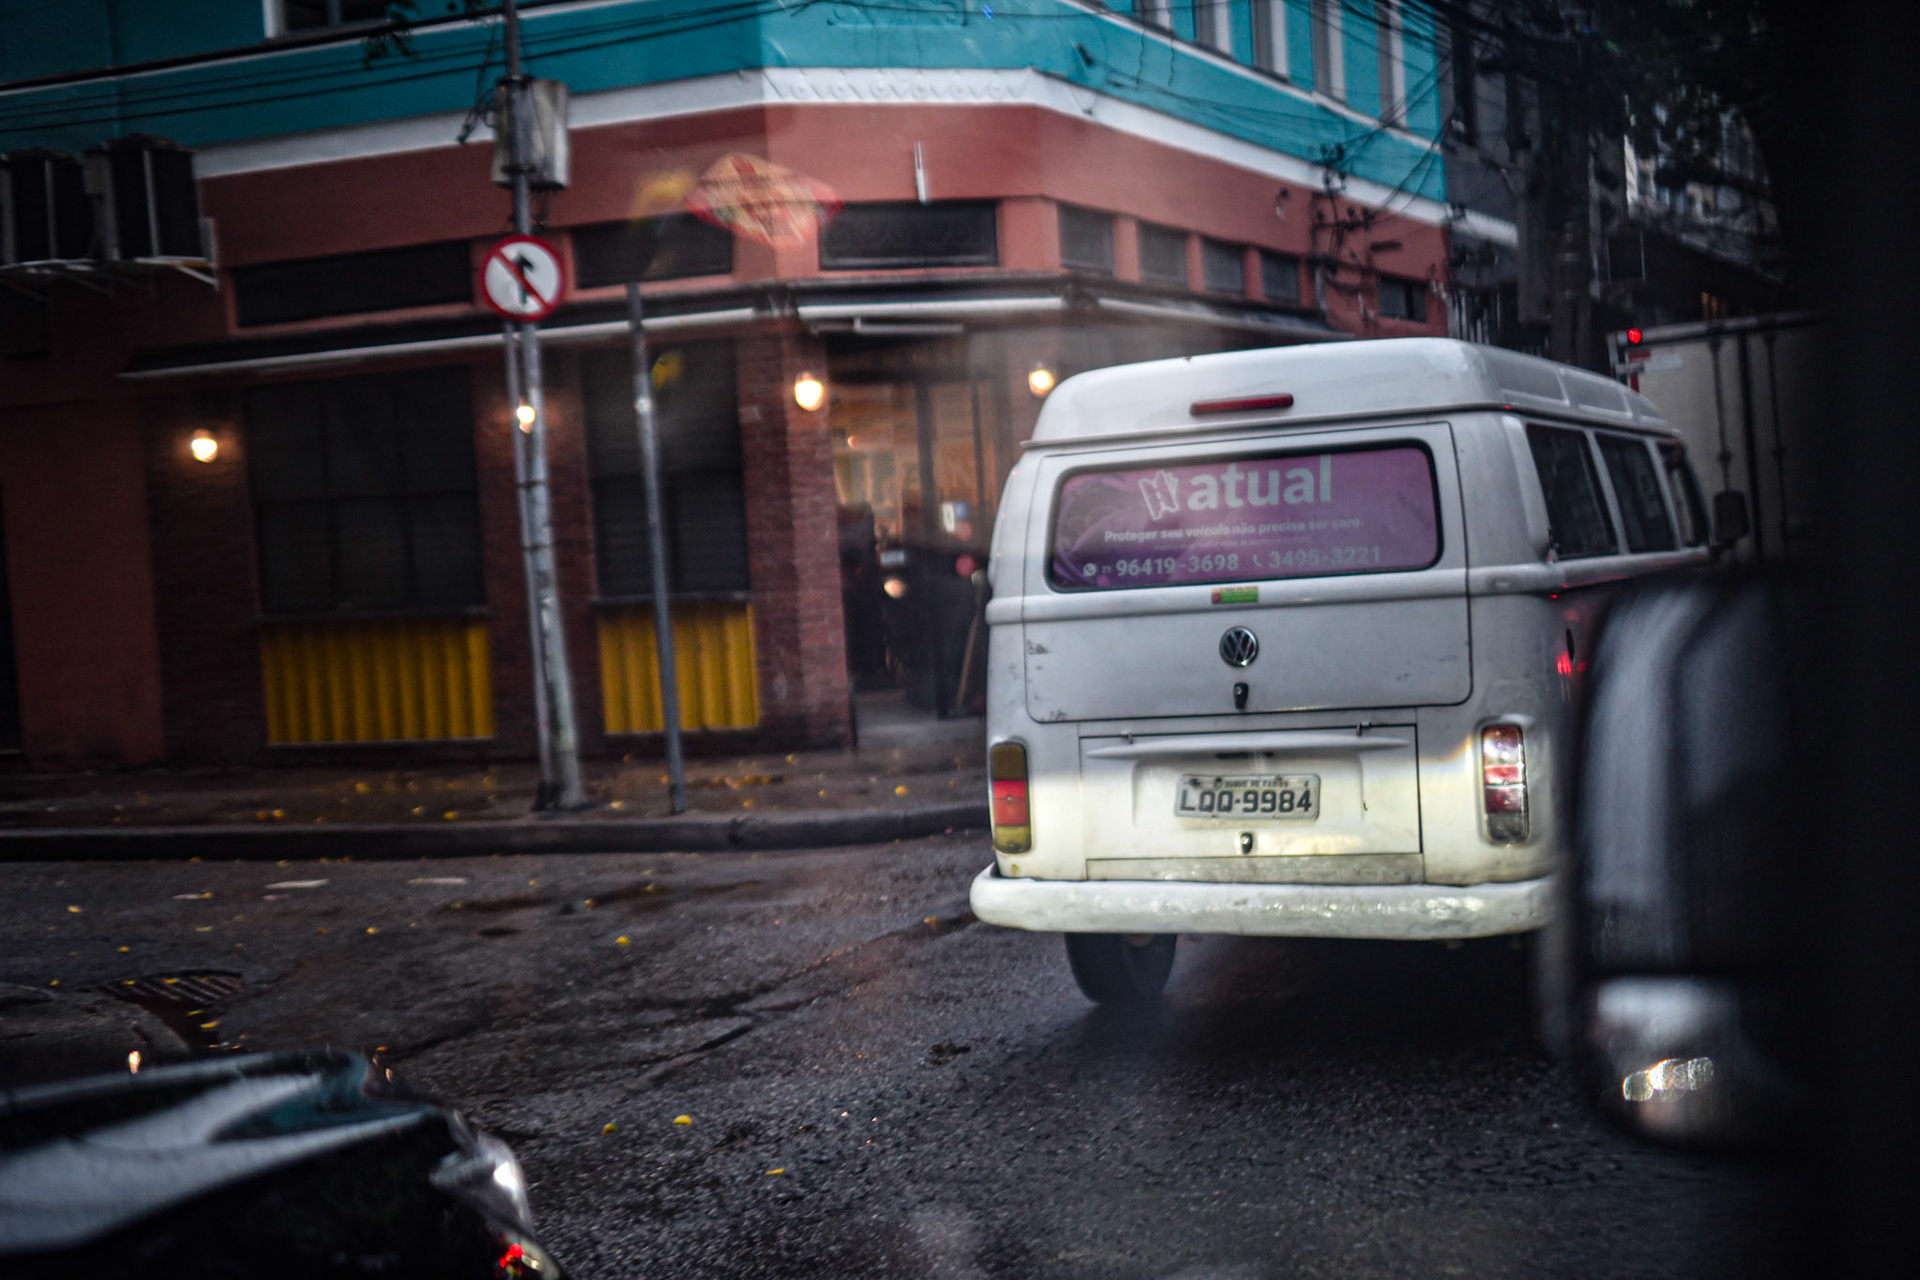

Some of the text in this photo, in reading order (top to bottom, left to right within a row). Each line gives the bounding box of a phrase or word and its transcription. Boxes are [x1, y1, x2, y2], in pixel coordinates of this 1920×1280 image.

[1187, 453, 1332, 512] atual
[1104, 530, 1158, 543] Proteger
[1160, 528, 1183, 539] seu
[1232, 522, 1256, 535] não
[1258, 520, 1305, 535] precisa
[1308, 519, 1329, 531] ser
[1115, 553, 1239, 576] 96419-3698
[1268, 545, 1381, 569] 3495-3221
